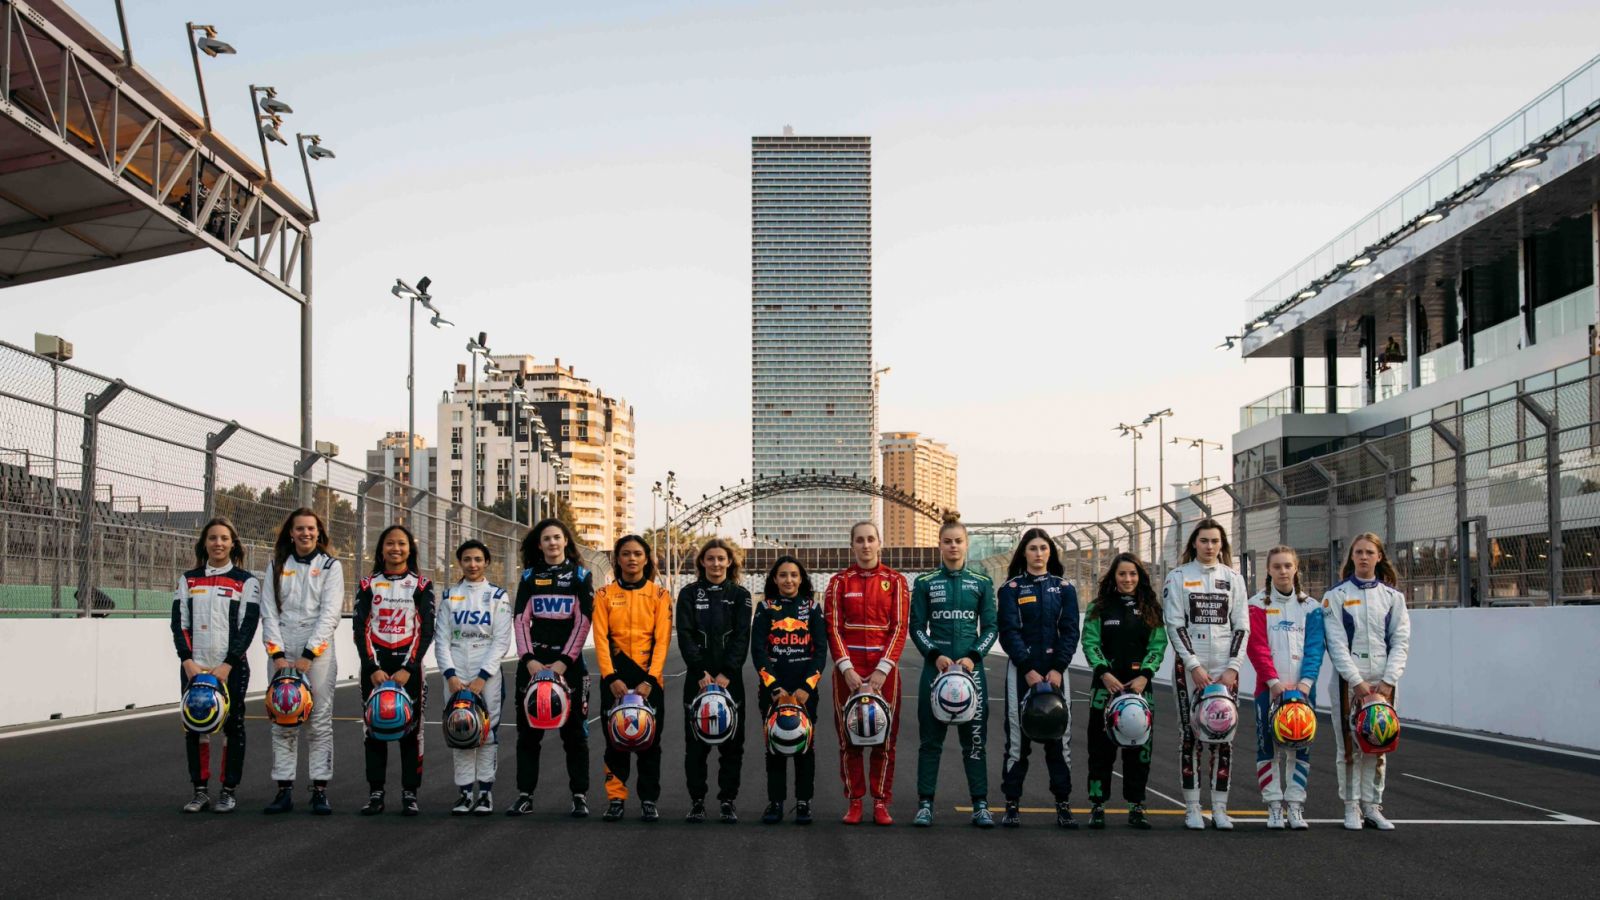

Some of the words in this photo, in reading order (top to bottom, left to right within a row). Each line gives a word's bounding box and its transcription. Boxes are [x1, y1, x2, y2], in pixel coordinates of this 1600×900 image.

[533, 598, 573, 613] BWT
[452, 610, 491, 626] VISA
[931, 609, 975, 619] aramco
[769, 632, 789, 645] Red
[790, 633, 811, 646] Bull
